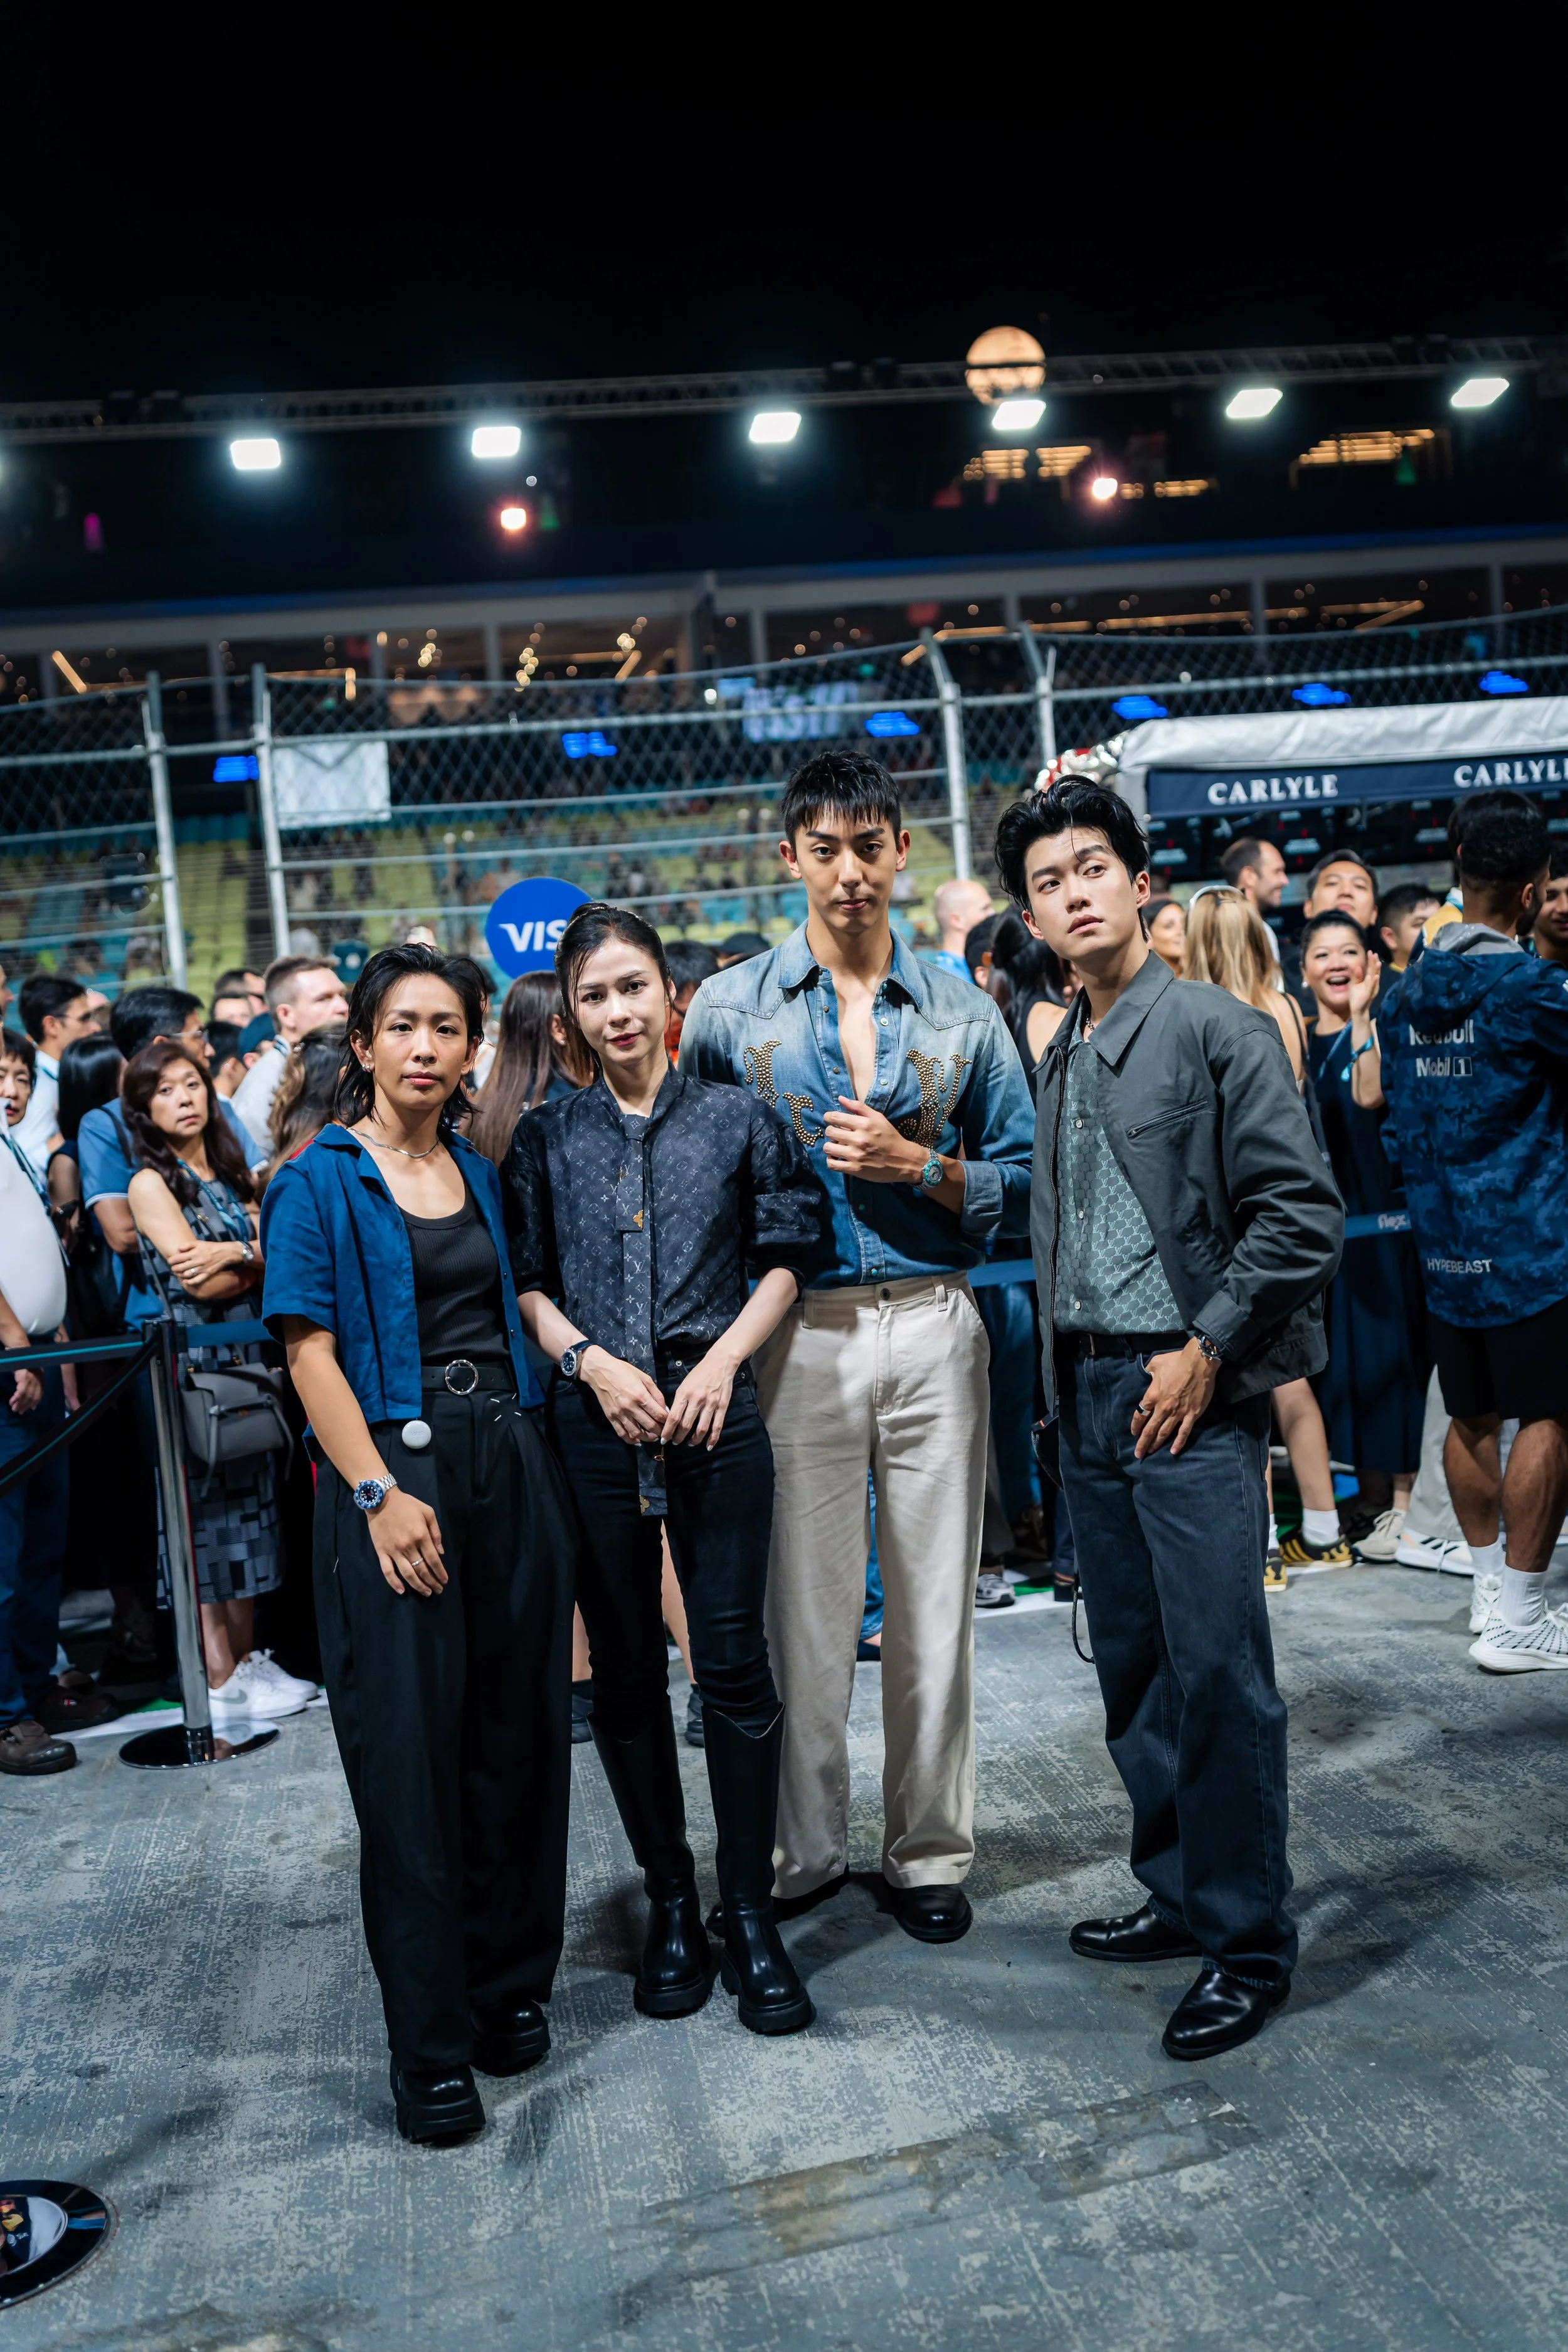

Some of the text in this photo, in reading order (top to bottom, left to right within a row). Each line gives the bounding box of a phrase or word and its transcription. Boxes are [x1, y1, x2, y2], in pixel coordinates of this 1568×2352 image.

[1453, 758, 1568, 788] CARLYL
[1207, 774, 1338, 806] CARLYLE
[499, 919, 568, 953] VIS
[1416, 1057, 1451, 1077] Mobil
[1427, 1258, 1492, 1273] HYPEBEAST
